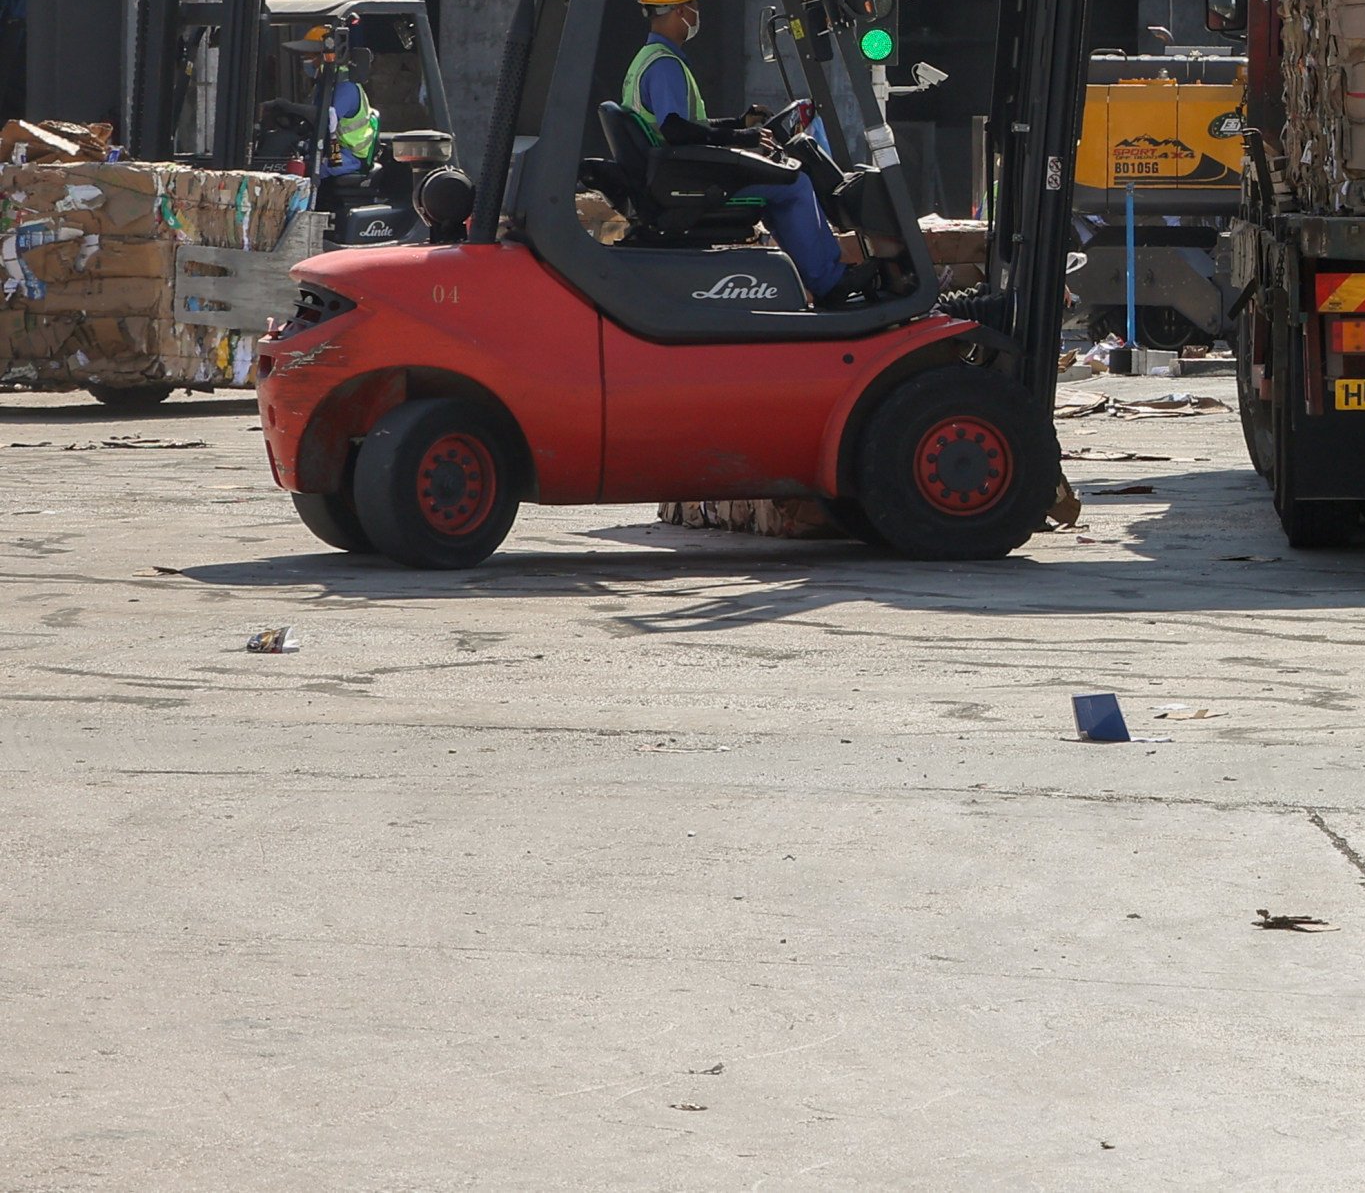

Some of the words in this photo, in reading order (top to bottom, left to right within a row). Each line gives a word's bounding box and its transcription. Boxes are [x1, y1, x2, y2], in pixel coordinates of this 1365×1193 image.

[1114, 148, 1158, 156] SPORT
[359, 219, 394, 237] Linde
[432, 284, 460, 304] 04
[691, 273, 778, 299] Linde
